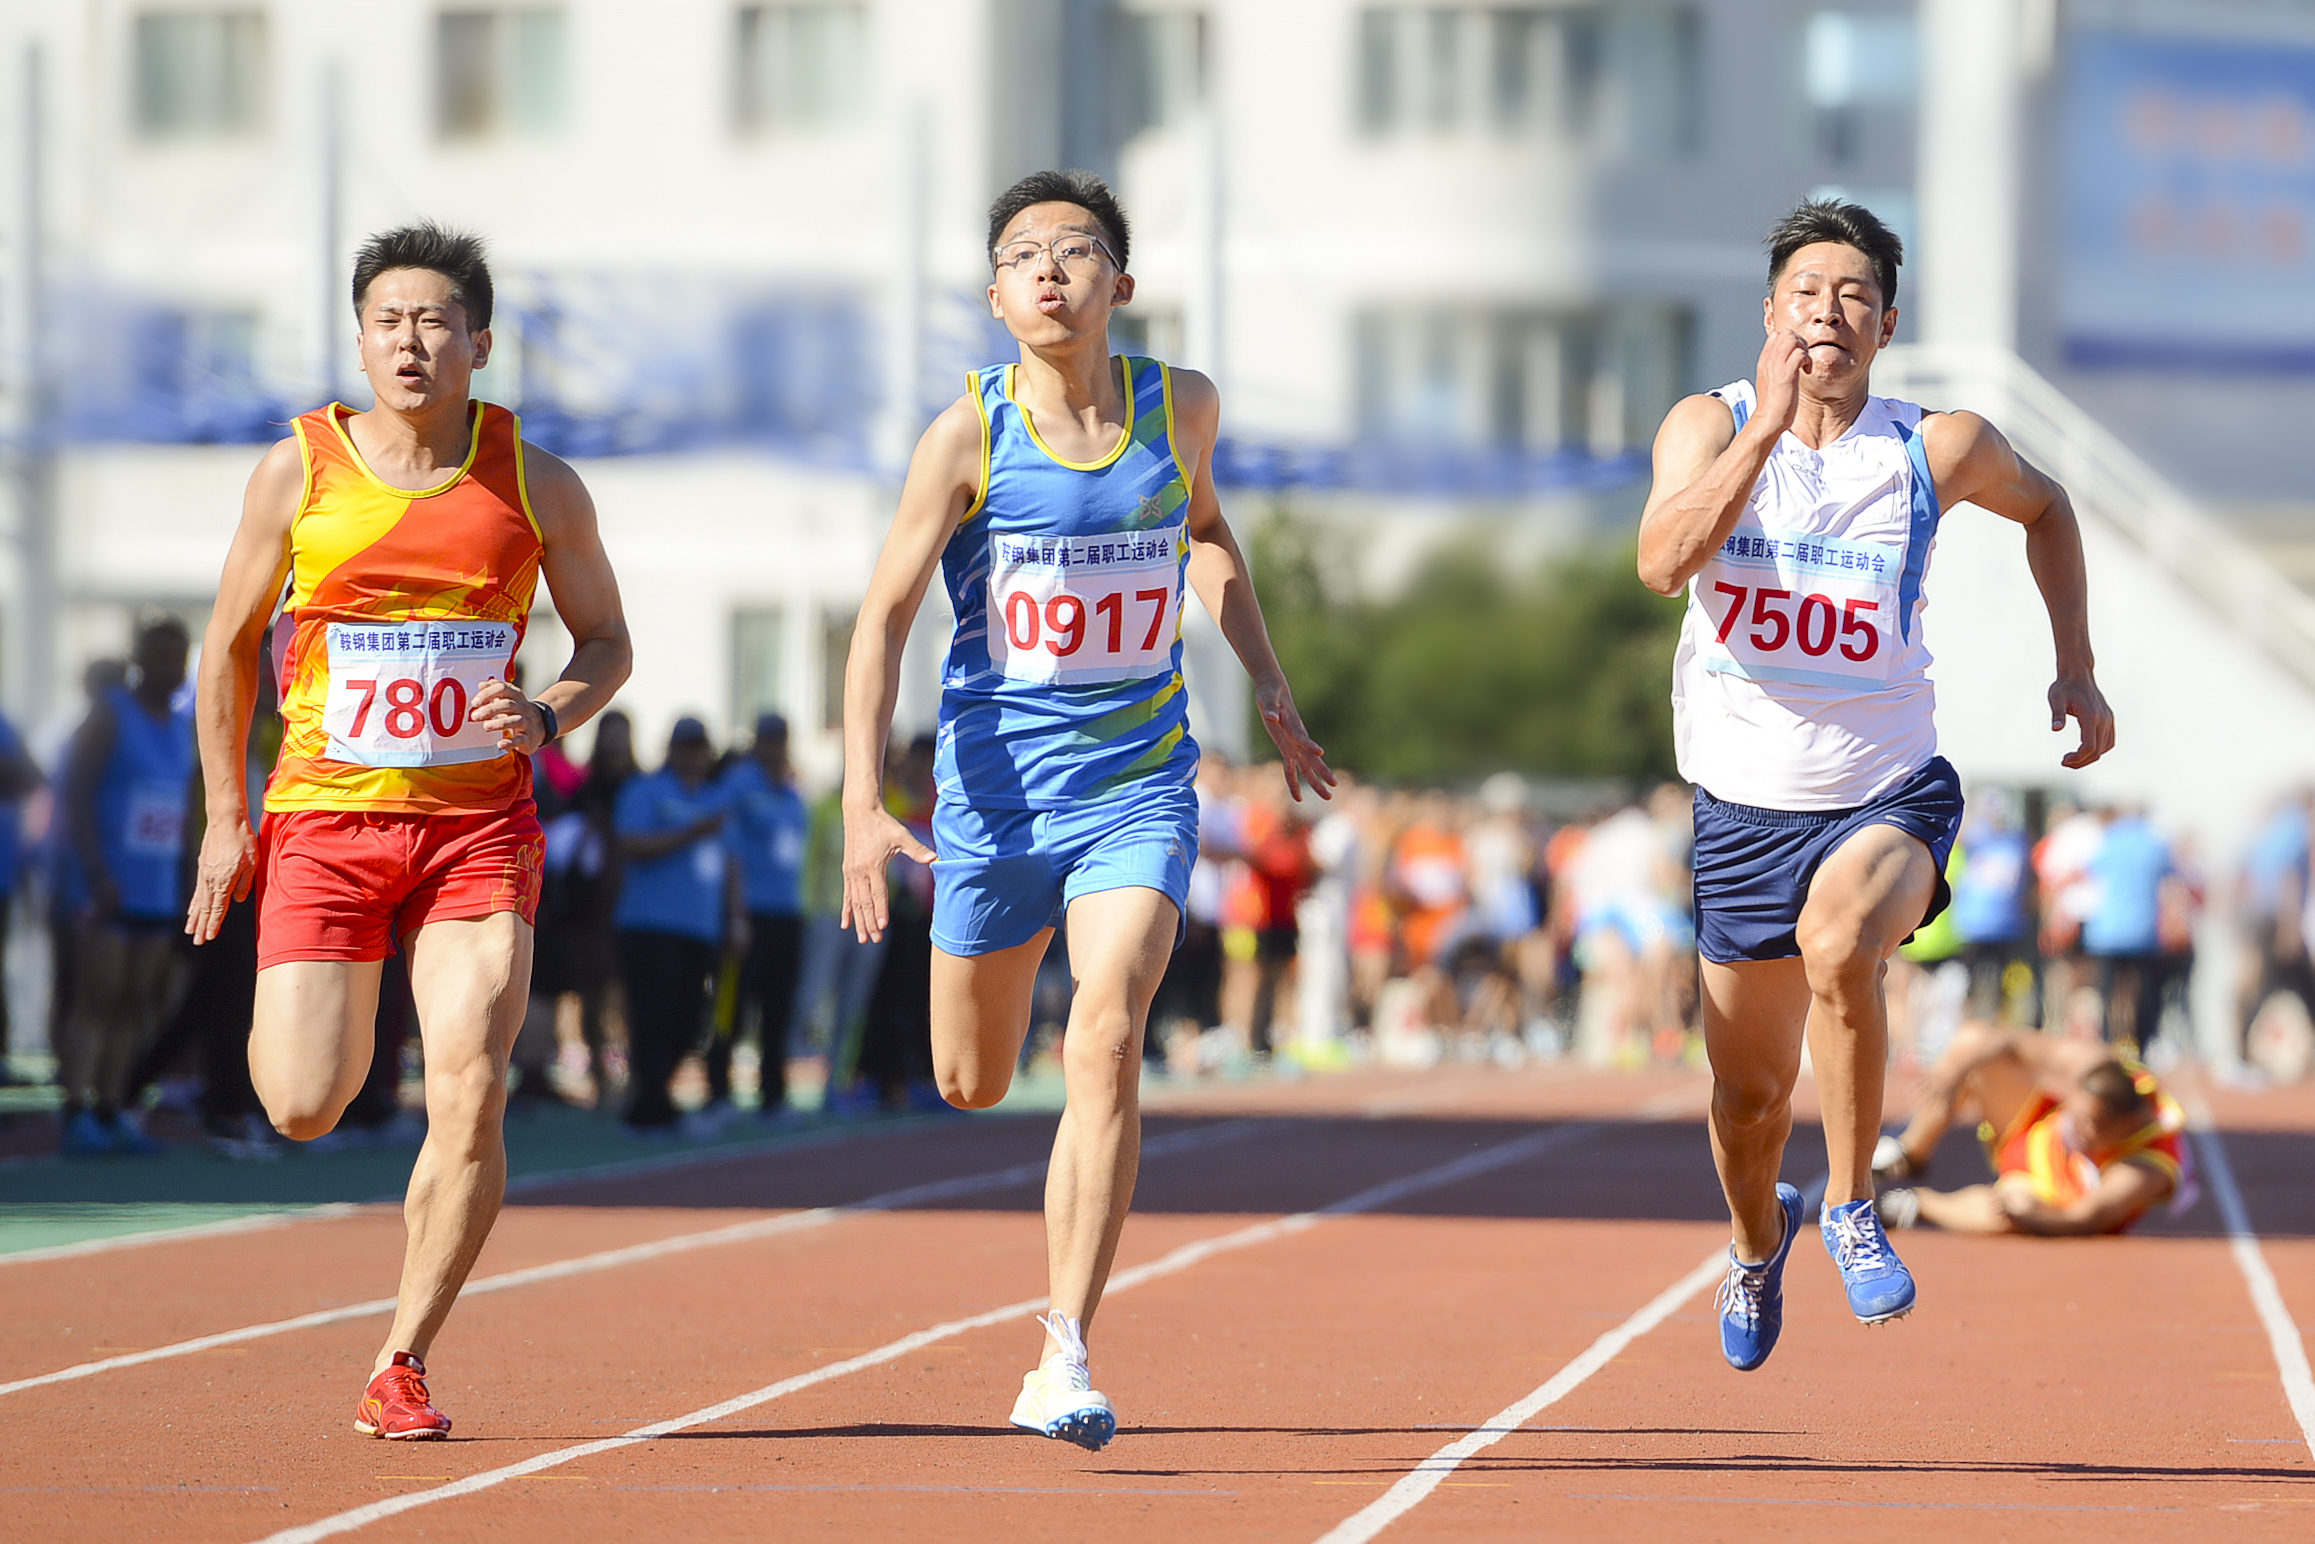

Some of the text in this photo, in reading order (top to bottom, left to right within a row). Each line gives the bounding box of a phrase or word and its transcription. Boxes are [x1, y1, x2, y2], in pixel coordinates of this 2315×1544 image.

[1720, 535, 1885, 572] 钢集团第二届职工运动会
[340, 630, 506, 651] 鞍钢集团第二届职工运动会
[1006, 587, 1168, 657] 0917
[1714, 581, 1879, 662] 7505
[346, 675, 497, 738] 780
